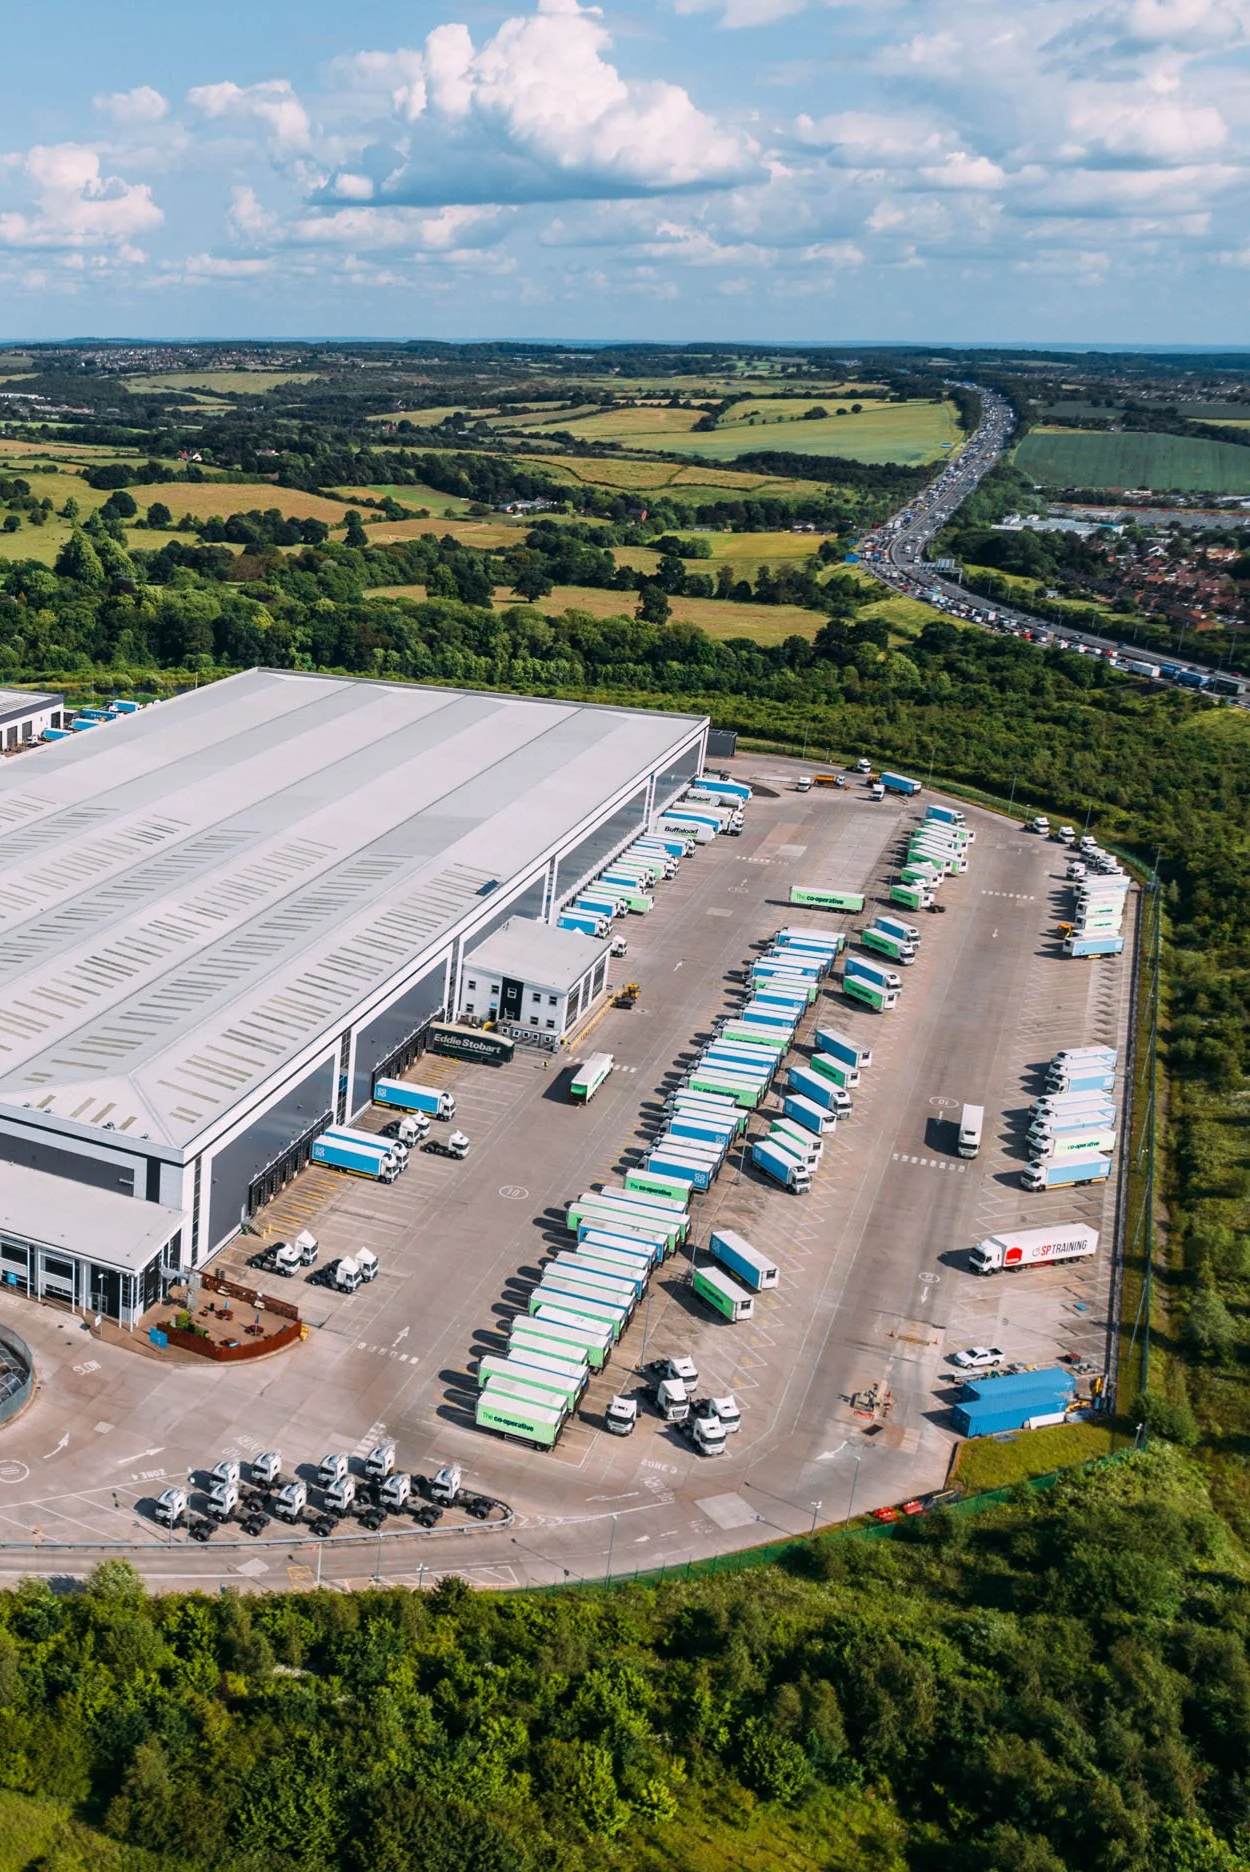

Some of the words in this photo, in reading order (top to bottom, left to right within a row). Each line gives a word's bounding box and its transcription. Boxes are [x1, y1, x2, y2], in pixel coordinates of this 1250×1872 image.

[664, 825, 699, 835] Buffaload
[806, 895, 844, 904] co-operative
[434, 1033, 462, 1046] Eddie
[462, 1038, 502, 1054] Stobart
[639, 1185, 672, 1196] co-operative
[1040, 1245, 1052, 1256] SP
[1051, 1240, 1088, 1254] TRAINING
[72, 1360, 102, 1376] SLOW
[483, 1411, 493, 1420] The
[493, 1415, 534, 1432] co-operative
